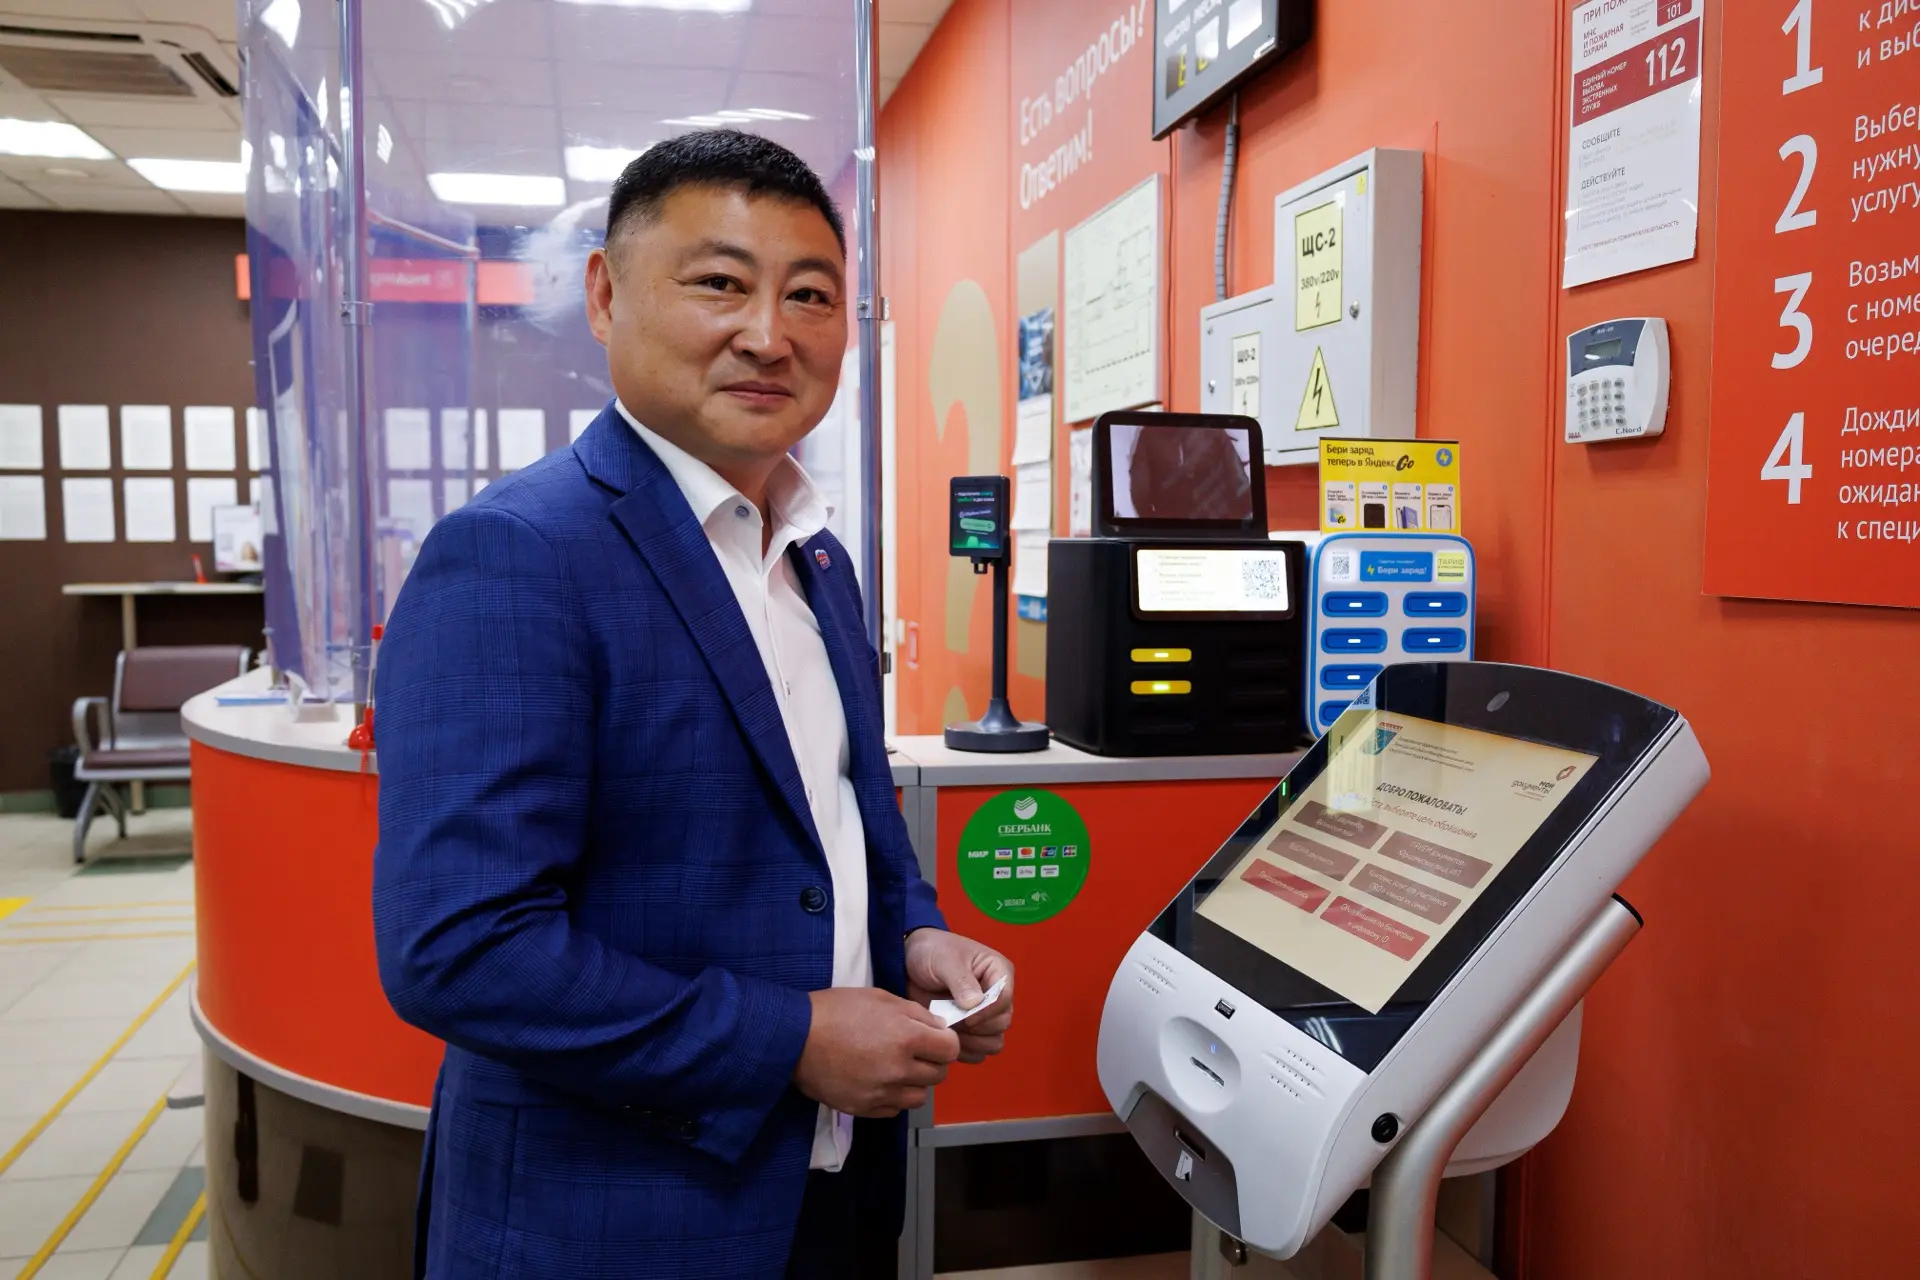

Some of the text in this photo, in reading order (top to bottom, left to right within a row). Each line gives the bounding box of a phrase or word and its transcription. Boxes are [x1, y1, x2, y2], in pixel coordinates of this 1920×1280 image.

[1583, 6, 1601, 24] ПРИ
[1667, 2, 1681, 19] 101
[1859, 10, 1871, 31] к
[1583, 27, 1597, 40] МЧС
[1589, 23, 1624, 46] ПОЖАРНАЯ
[1583, 41, 1608, 58] ОХРАНА
[1781, 0, 1823, 96] 1
[1858, 47, 1871, 69] и
[1645, 37, 1686, 87] 112
[1020, 92, 1052, 146] Есть
[1855, 103, 1920, 143] Выбе
[1582, 127, 1621, 150] СООБЩИТЕ
[1020, 107, 1092, 210] Ответим!
[1580, 166, 1626, 190] ДЕЙСТВУЙТЕ
[1775, 134, 1818, 234] 2
[1302, 227, 1336, 257] ЩС-2
[1771, 271, 1813, 370] 3
[1847, 304, 1858, 323] с
[1841, 406, 1920, 437] Дожди
[1326, 444, 1374, 456] Бери заряд
[1760, 412, 1813, 505] 4
[1327, 458, 1356, 468] теперь
[1365, 457, 1395, 468] Яндекс
[1396, 455, 1415, 471] Go
[1837, 521, 1849, 539] к
[1376, 781, 1469, 815] ДОБРО ПОЖАЛОВАТЬ!
[998, 824, 1051, 834] СБЕРБАНК
